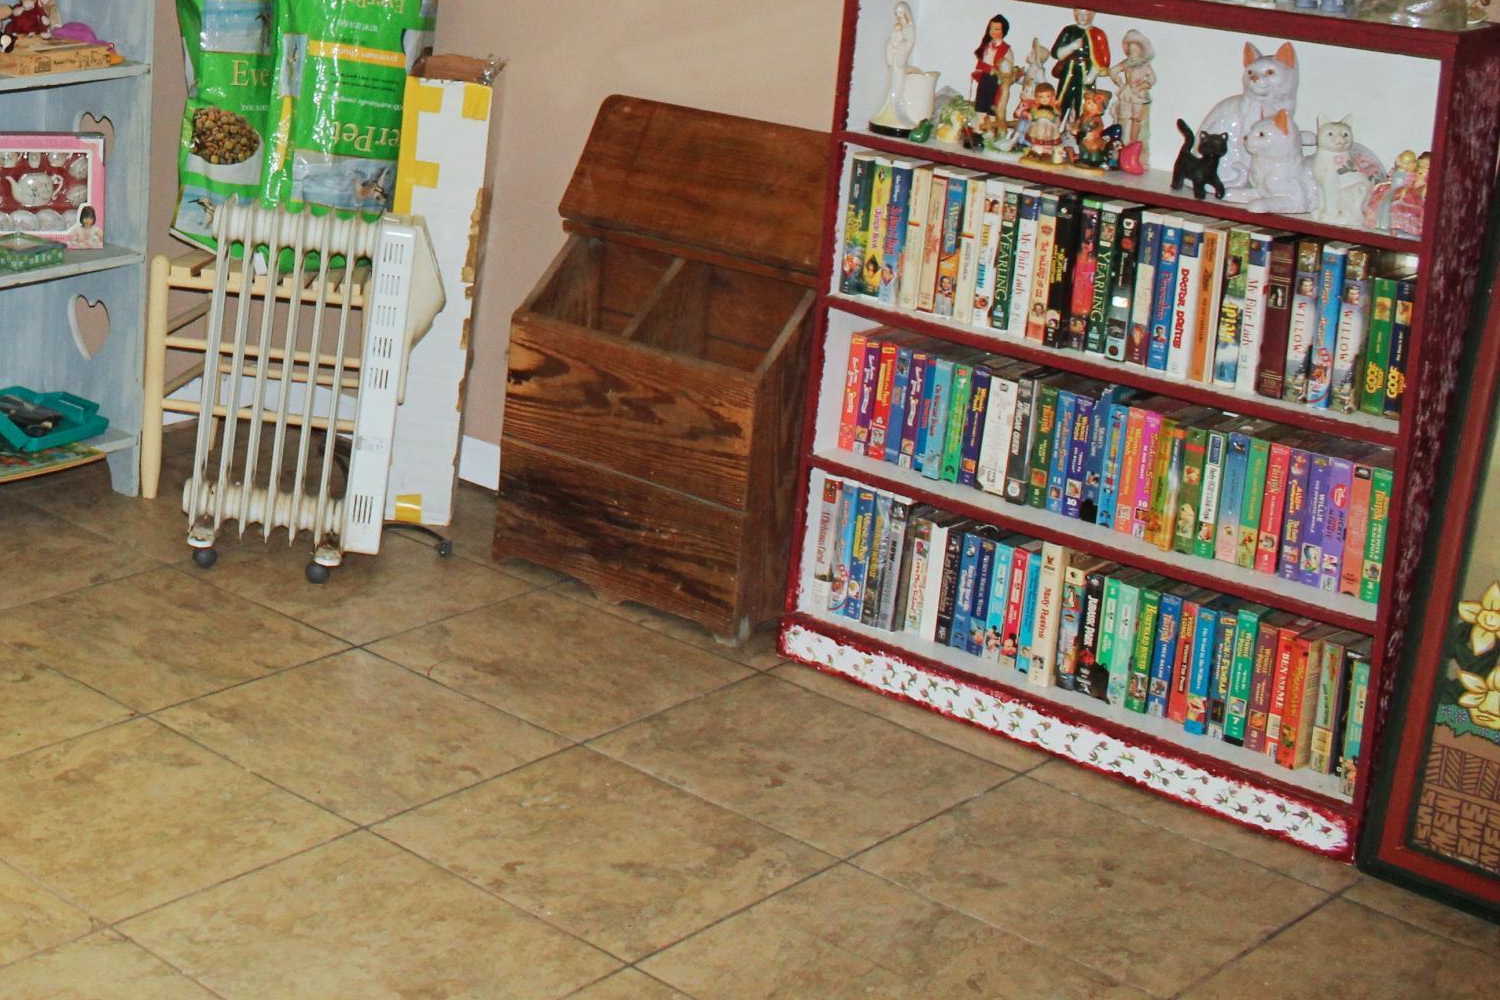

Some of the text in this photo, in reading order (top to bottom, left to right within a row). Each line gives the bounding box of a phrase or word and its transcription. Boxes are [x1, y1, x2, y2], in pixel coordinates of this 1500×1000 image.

[995, 231, 1012, 301] YEARLING
[1014, 232, 1031, 296] My Fair Lady
[1091, 251, 1111, 322] YEARLING
[1156, 271, 1172, 320] Pinocchio
[1177, 268, 1190, 306] DOCTOR
[1242, 278, 1258, 348] My Fair Lady
[1293, 302, 1306, 353] WILLOW
[1339, 310, 1353, 362] WILLOW
[1365, 362, 1377, 393] GOOF
[1386, 366, 1398, 398] GOOF
[1011, 400, 1024, 455] AFRICAN QUEEN
[1316, 493, 1325, 522] WILLIE
[944, 553, 955, 567] Les
[1037, 587, 1052, 639] Mary Poppins
[1083, 595, 1098, 647] JURASSIC PARK
[1186, 616, 1194, 637] VIDEO
[1138, 604, 1157, 669] HOMEWARD BOUND
[1236, 638, 1245, 657] POOH
[1242, 632, 1253, 658] WINNIE
[1255, 654, 1264, 673] POOH
[1261, 648, 1271, 674] WINNIE
[1280, 652, 1290, 673] BEN
[1275, 691, 1285, 709] ME
